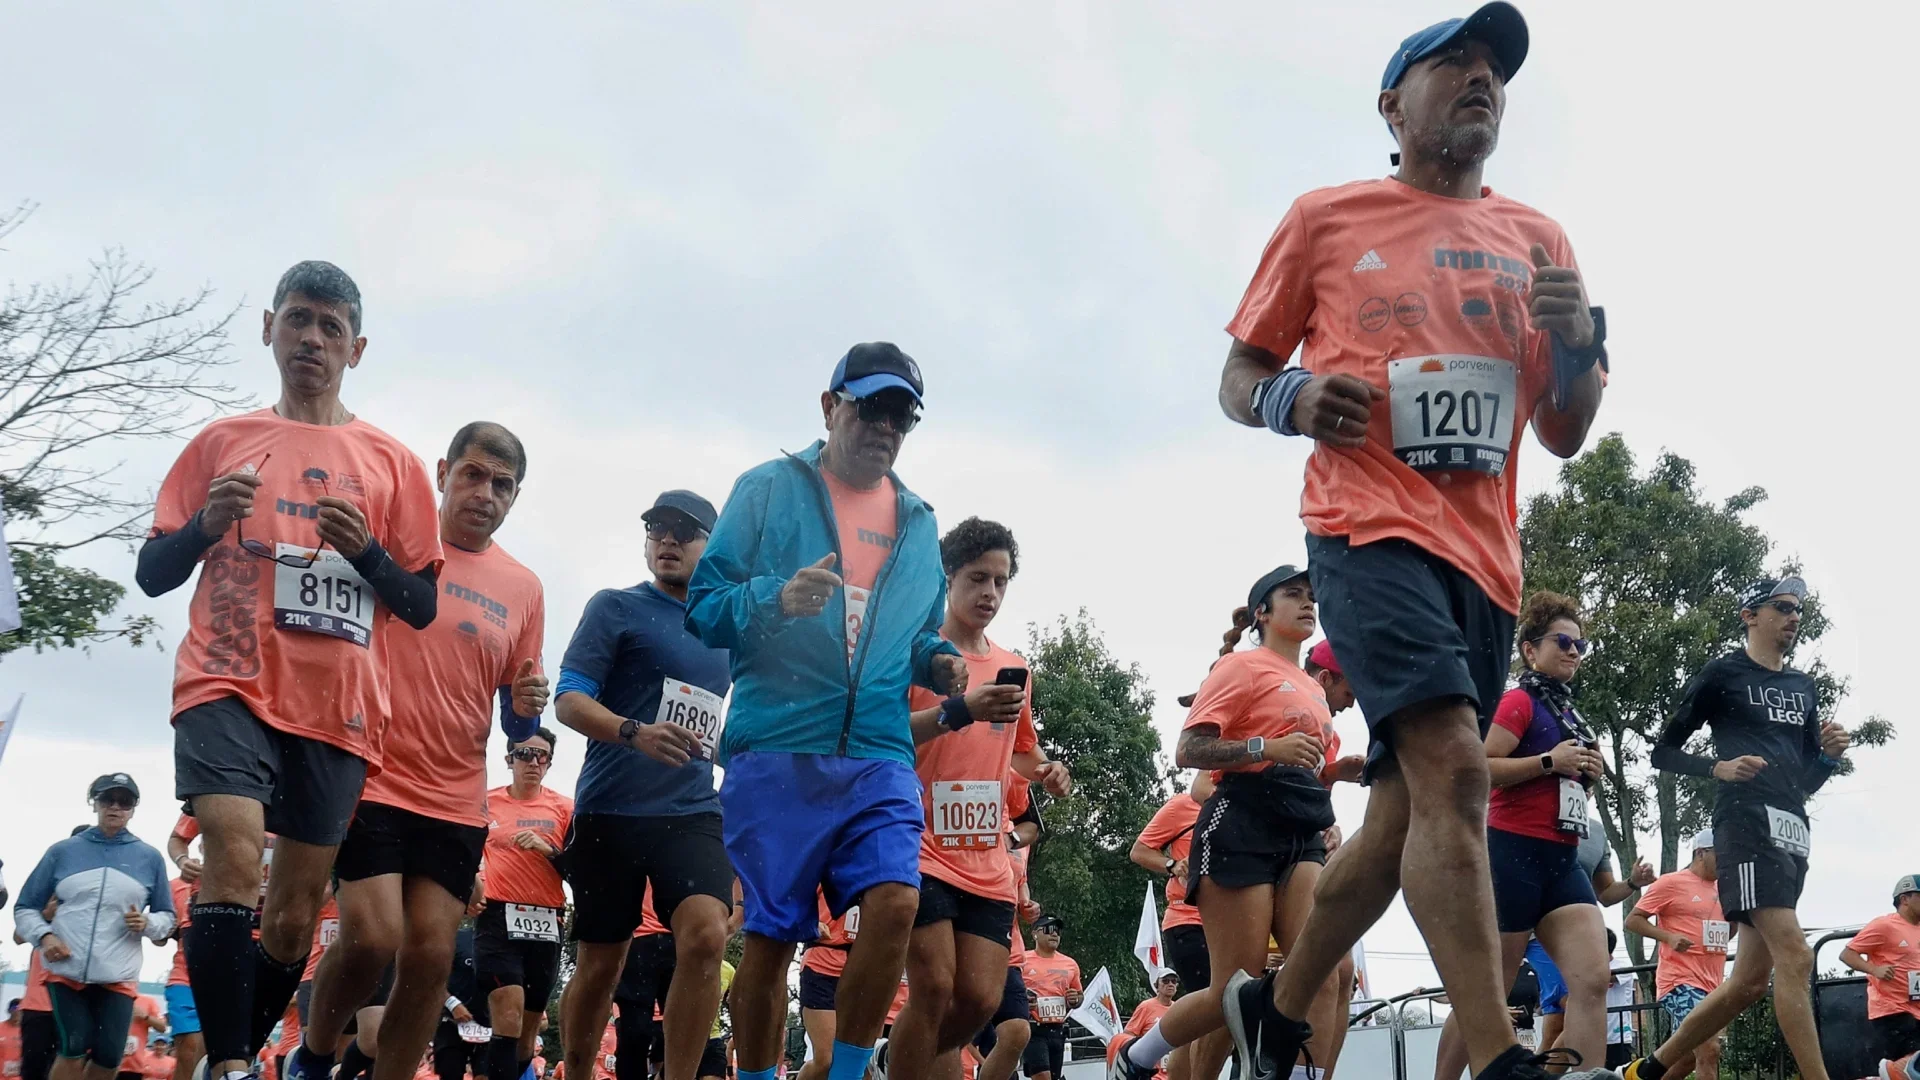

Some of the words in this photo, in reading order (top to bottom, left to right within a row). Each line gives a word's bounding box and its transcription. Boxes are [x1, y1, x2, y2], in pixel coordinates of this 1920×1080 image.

[1353, 260, 1388, 272] adidas
[1449, 360, 1496, 372] porvenir
[1415, 389, 1500, 439] 1207
[1406, 449, 1439, 466] 21K
[300, 572, 361, 619] 8151
[285, 612, 312, 627] 21K
[1747, 685, 1805, 711] LIGHT
[666, 699, 717, 742] 16892
[1768, 707, 1805, 726] LEGS
[940, 801, 998, 831] 10623
[1562, 822, 1576, 831] 21K
[1776, 816, 1806, 845] 2001
[941, 837, 960, 847] 21K
[514, 917, 553, 933] 4032
[1041, 1004, 1065, 1016] 10497
[461, 1024, 490, 1036] 12743
